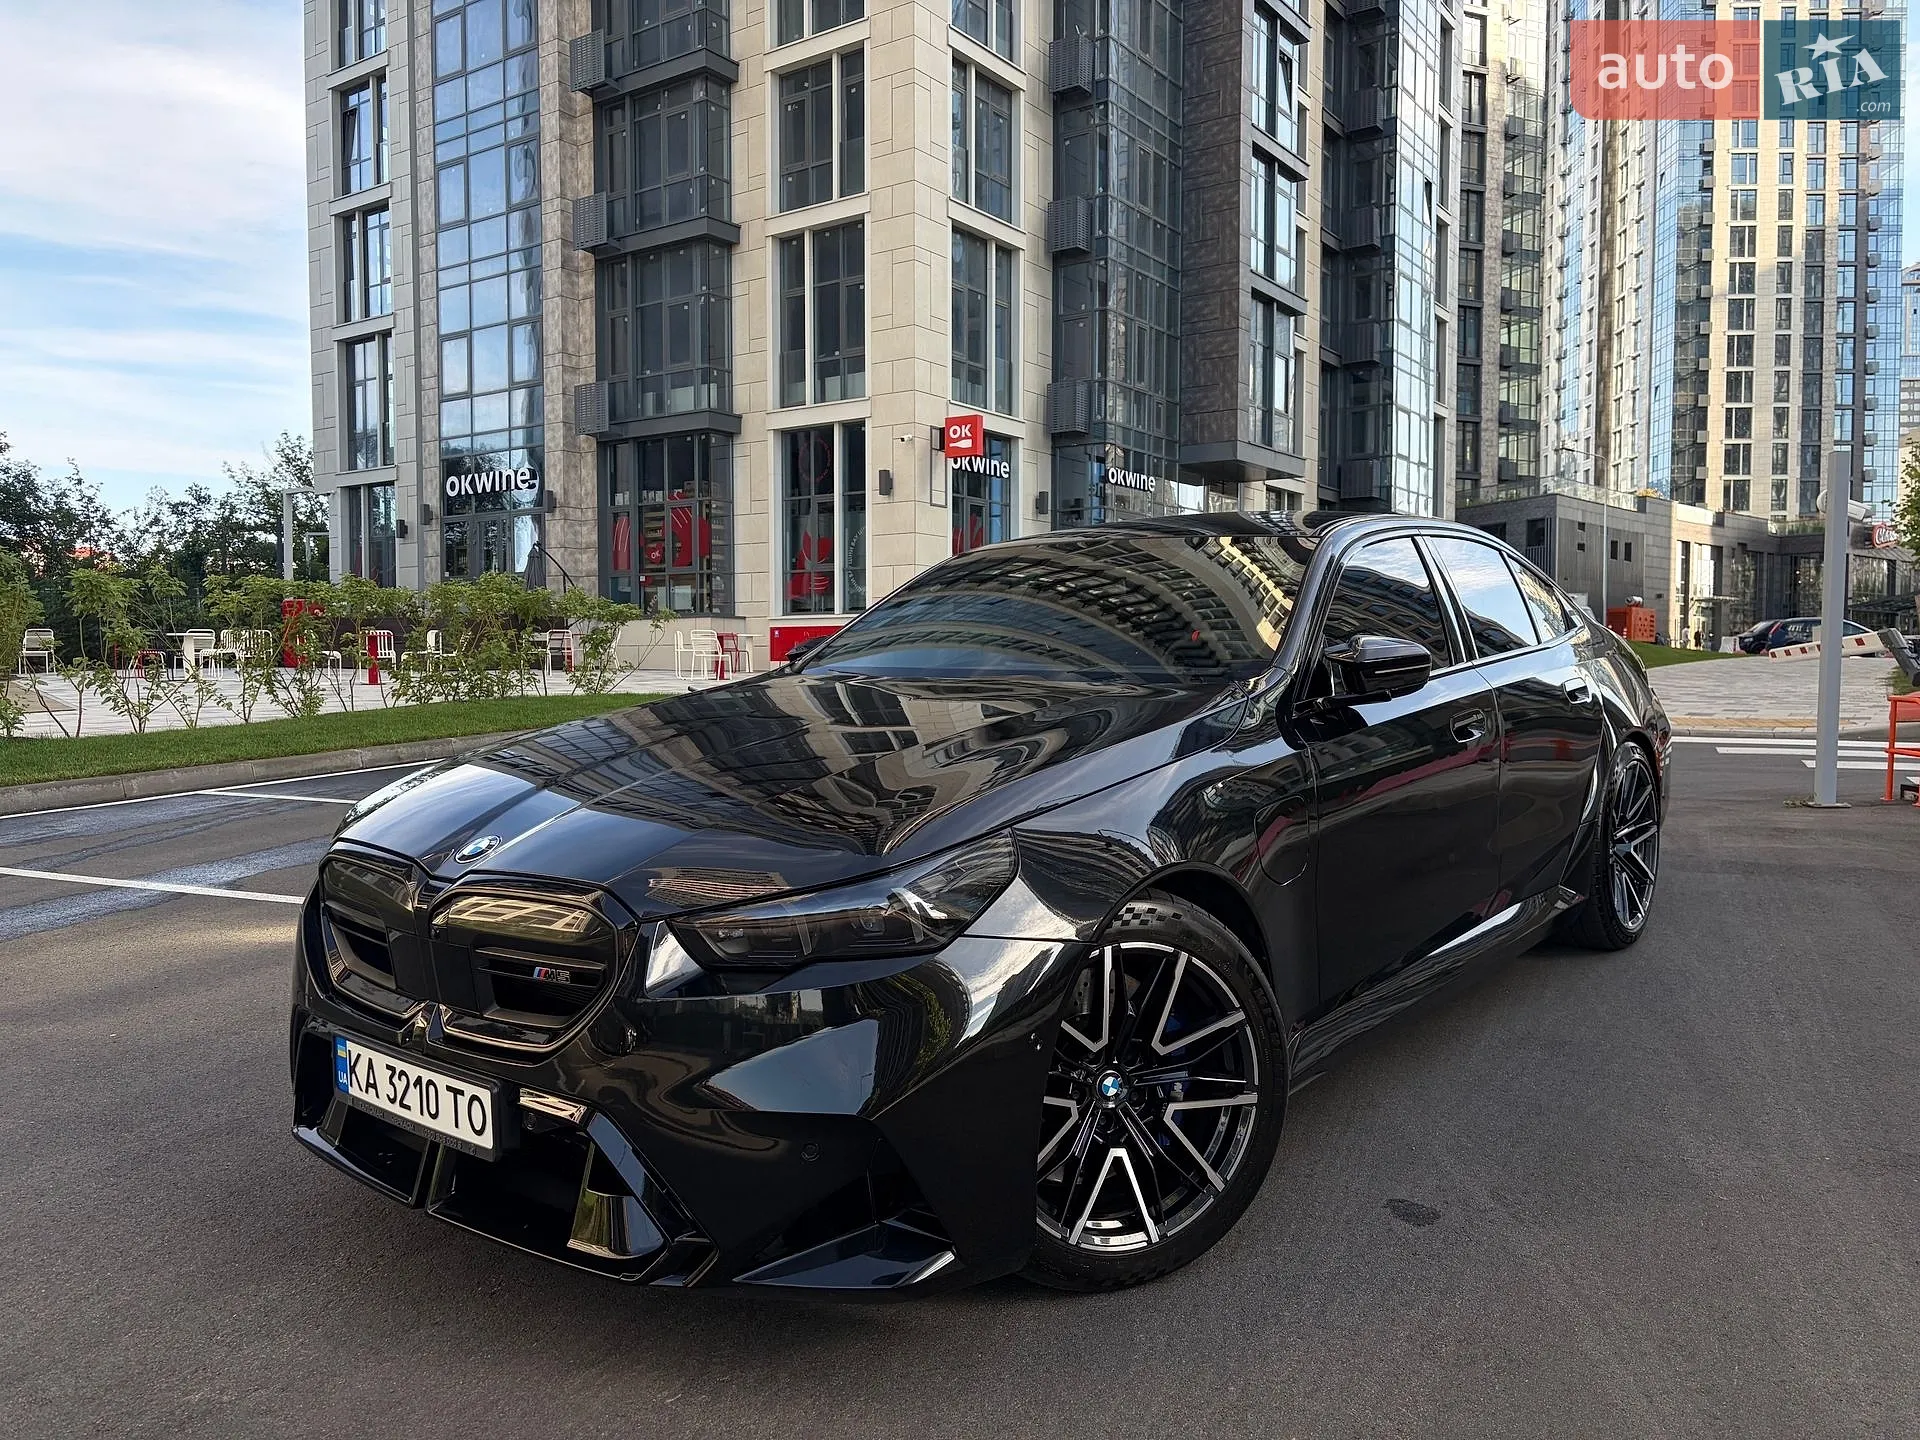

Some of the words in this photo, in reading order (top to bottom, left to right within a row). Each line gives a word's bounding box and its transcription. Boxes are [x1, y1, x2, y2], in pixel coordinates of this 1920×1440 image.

[949, 424, 972, 439] OK
[338, 1070, 348, 1085] UA
[348, 1049, 380, 1099] KA
[385, 1064, 440, 1120] 3210
[445, 1084, 487, 1137] TO
